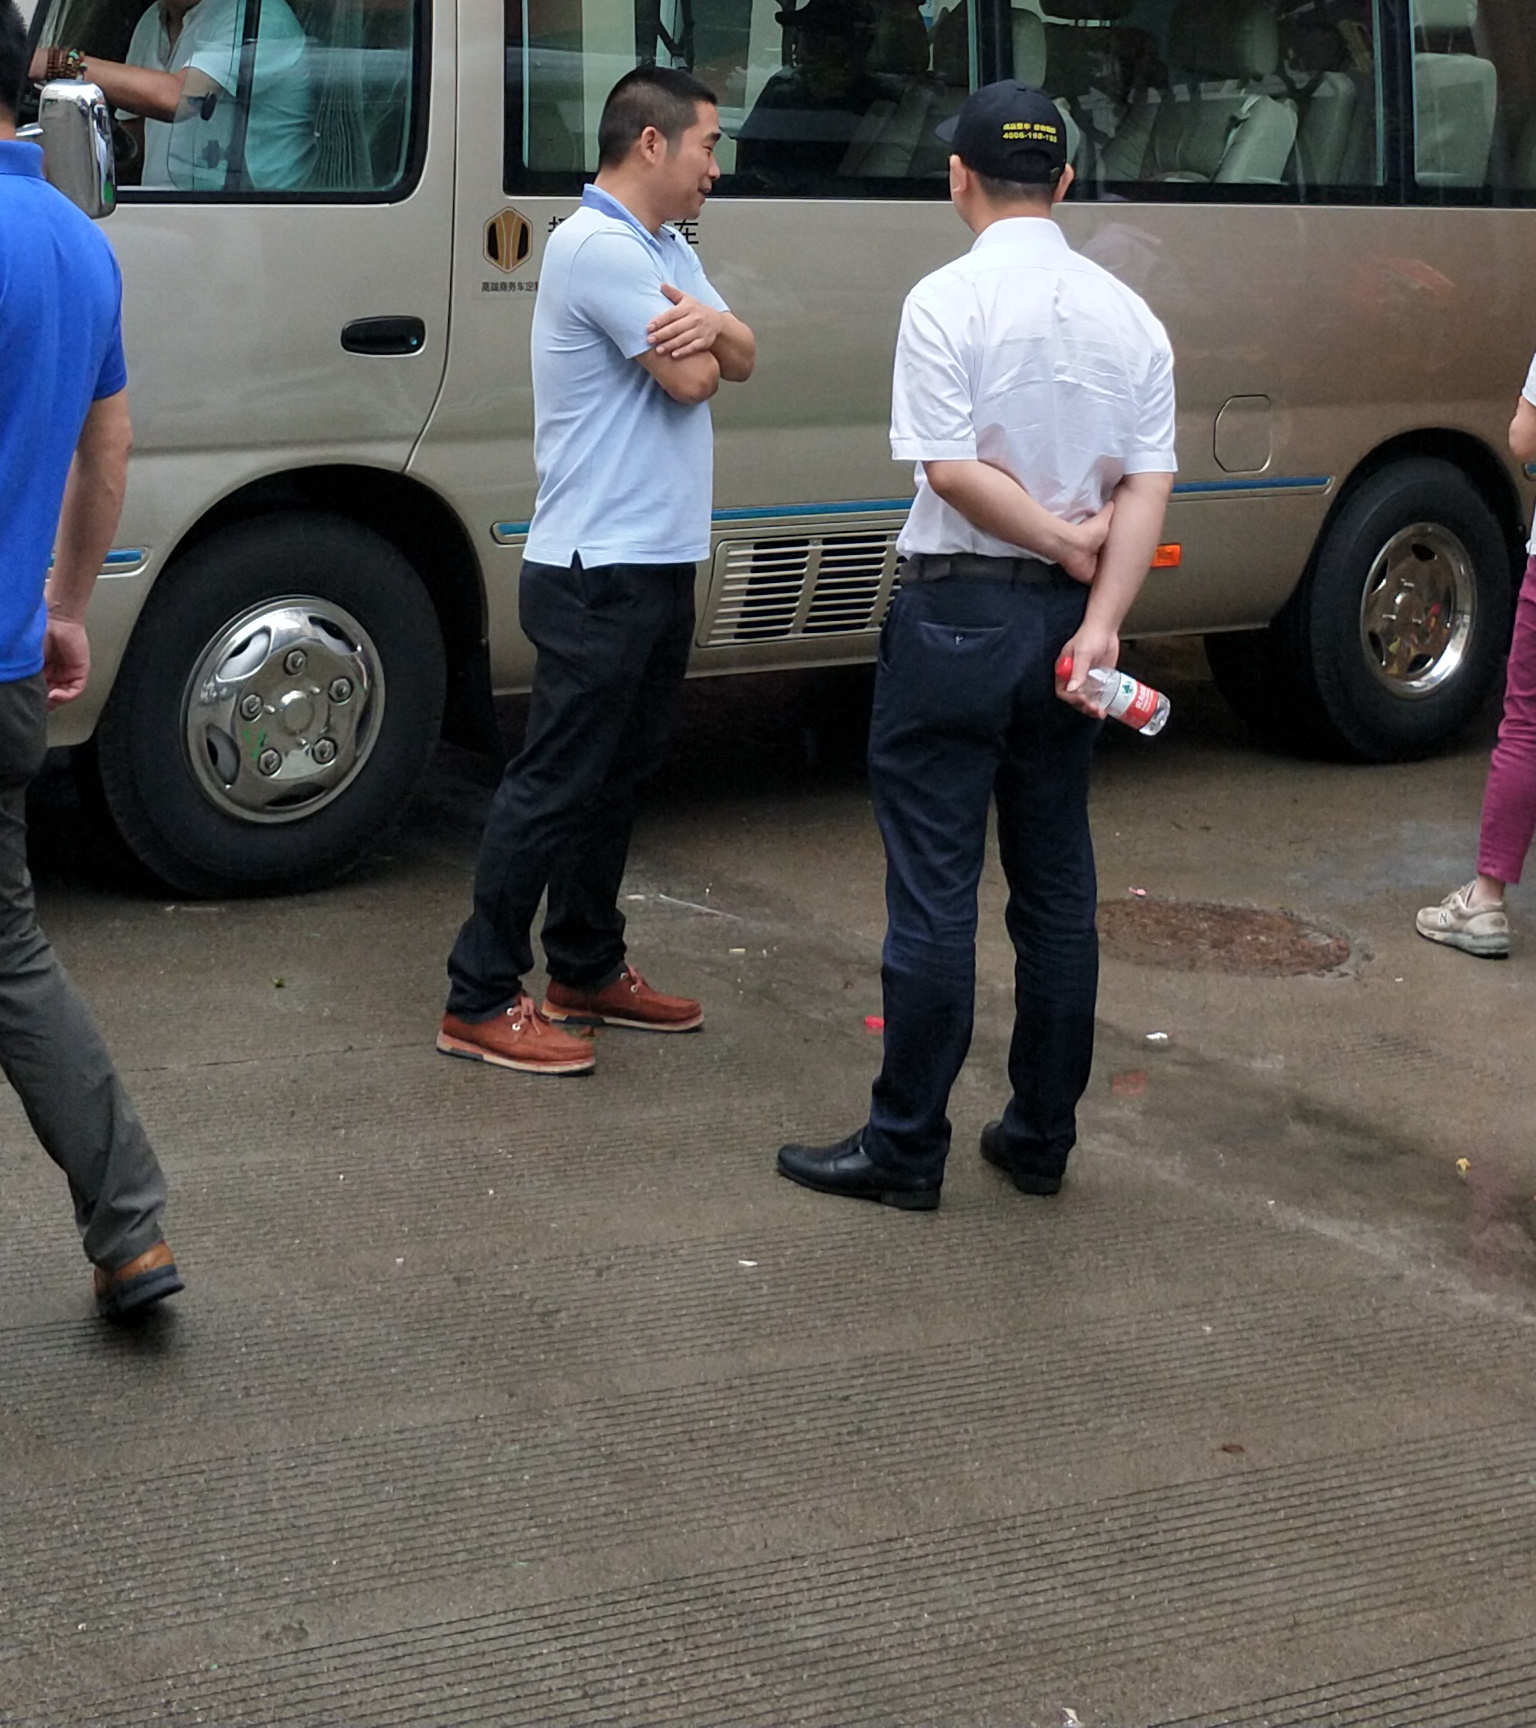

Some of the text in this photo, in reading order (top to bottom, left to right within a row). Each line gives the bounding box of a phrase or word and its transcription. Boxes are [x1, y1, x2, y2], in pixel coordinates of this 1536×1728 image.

[481, 281, 539, 292] 高端商务车定
